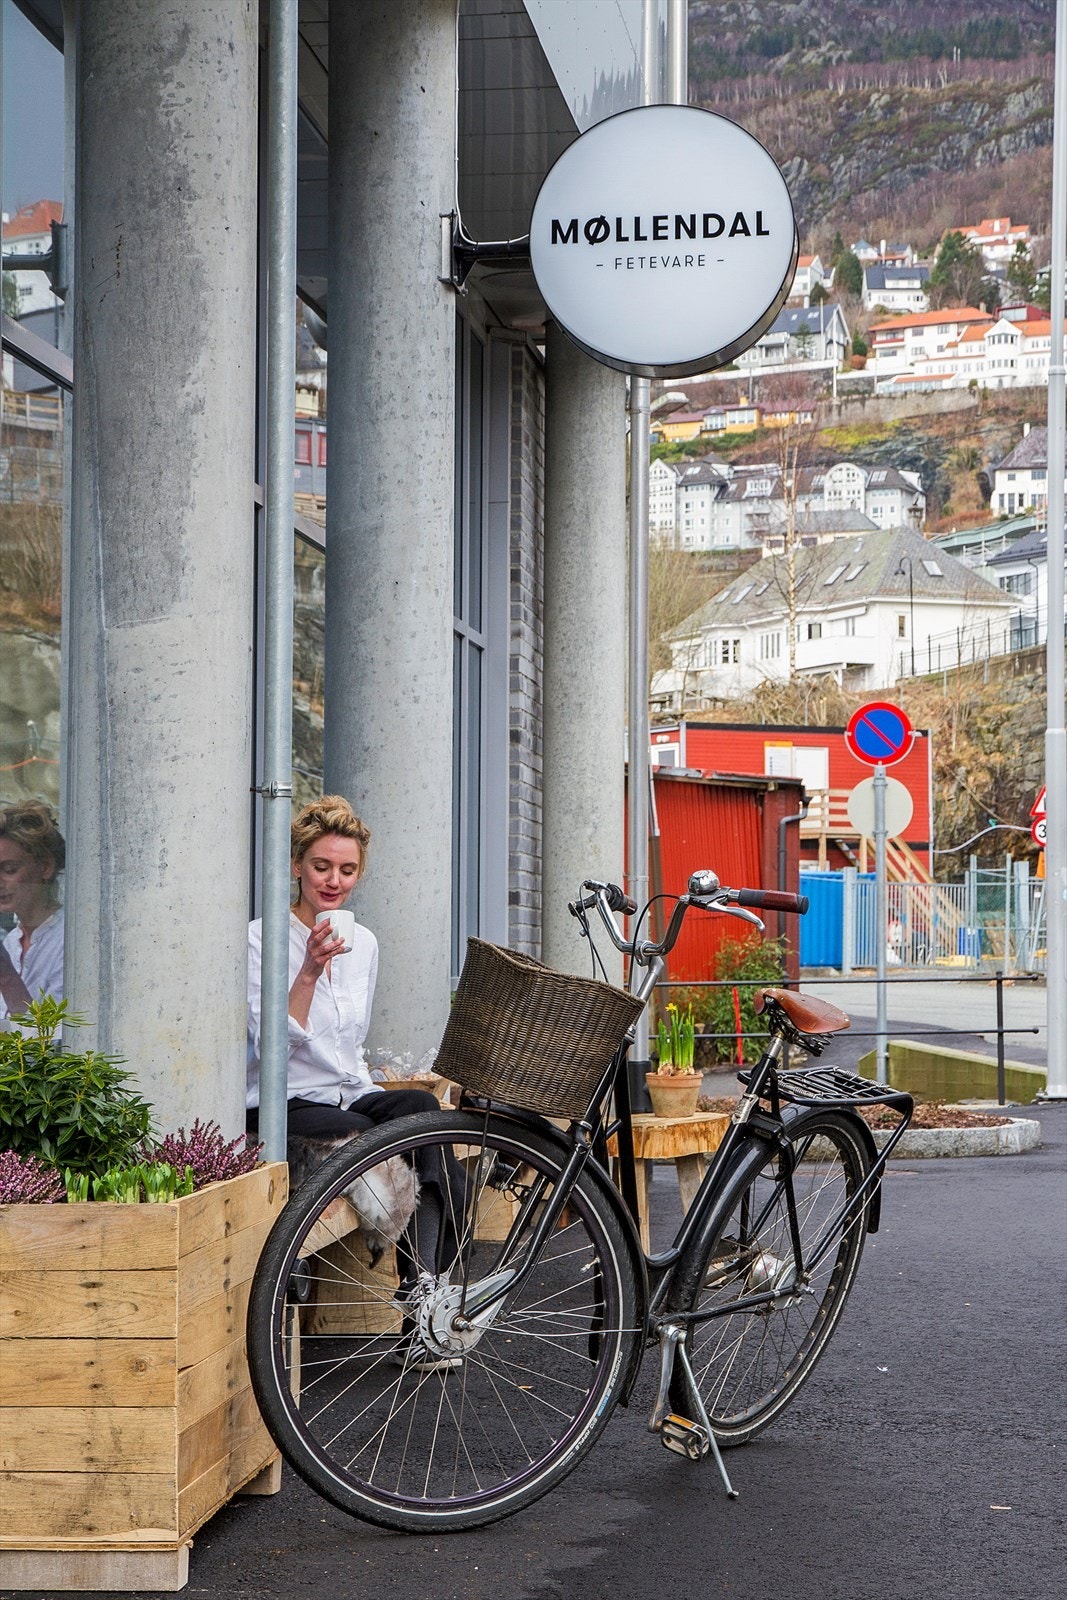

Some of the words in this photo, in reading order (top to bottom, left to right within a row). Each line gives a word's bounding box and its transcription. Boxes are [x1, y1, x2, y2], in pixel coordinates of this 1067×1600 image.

[551, 210, 770, 246] MØLLENDAL
[614, 254, 706, 270] FETEVARE
[1038, 824, 1047, 838] 3
